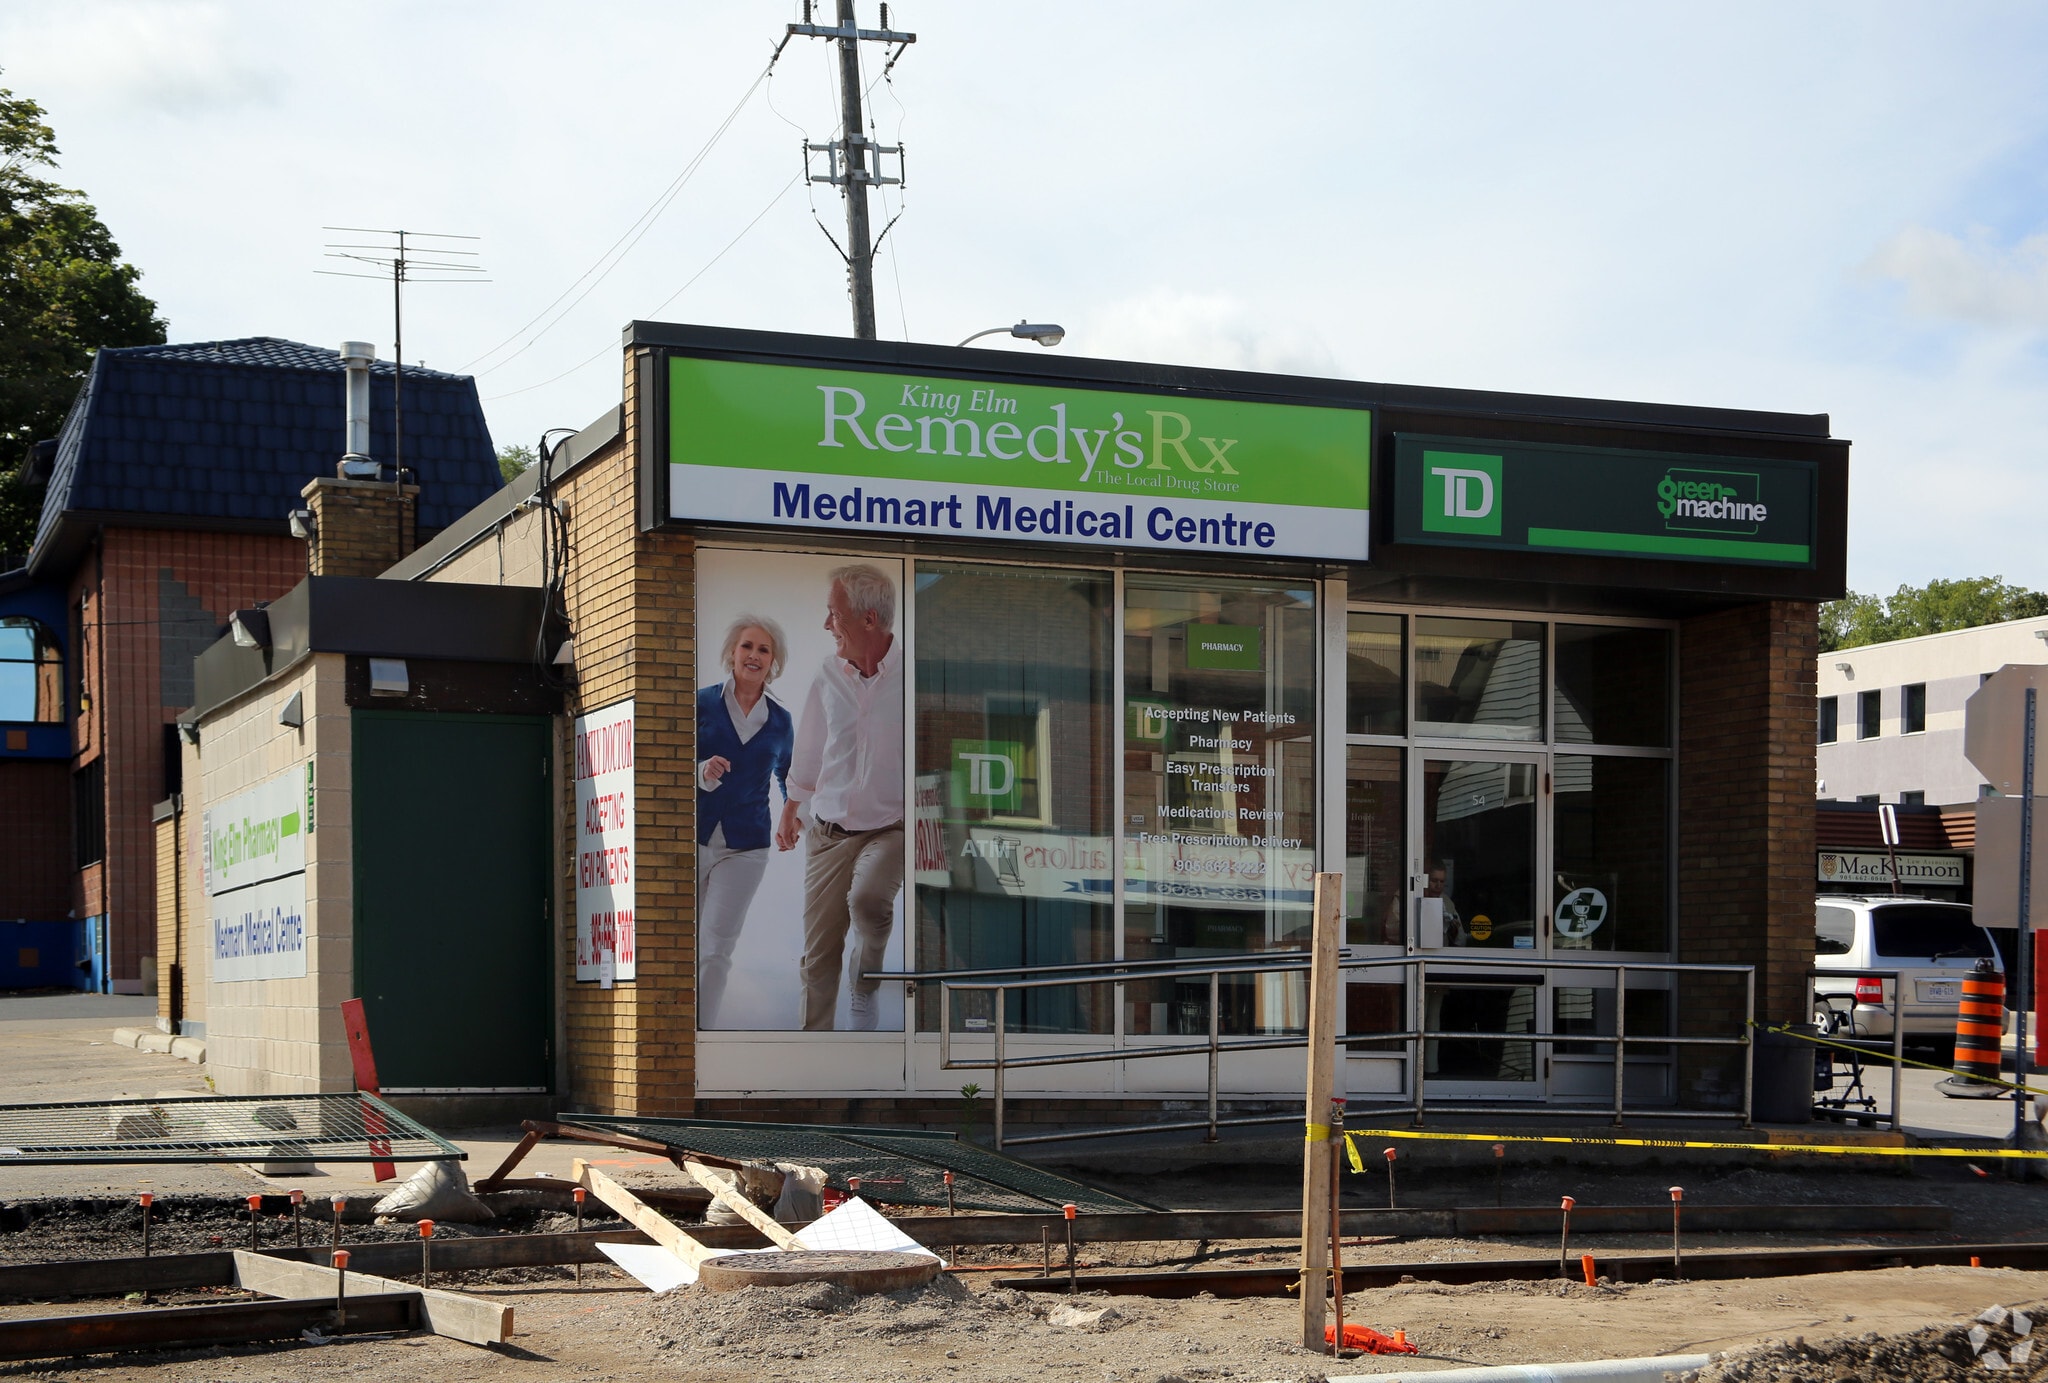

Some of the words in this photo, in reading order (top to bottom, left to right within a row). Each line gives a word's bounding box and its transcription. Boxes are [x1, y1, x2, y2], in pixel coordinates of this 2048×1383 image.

[900, 384, 960, 417] King
[968, 388, 1018, 415] Elm
[1095, 470, 1122, 485] The
[1126, 473, 1162, 487] Local
[1166, 475, 1201, 494] Drug
[1204, 478, 1240, 493] Store
[1431, 467, 1494, 518] TD
[1657, 475, 1723, 519] green
[1677, 496, 1767, 521] machine
[773, 482, 962, 529] Medmart
[976, 494, 1134, 539] Medical
[1146, 505, 1276, 548] Centre
[1201, 642, 1244, 653] PHARMACY
[1144, 706, 1210, 723] Accepting
[1213, 709, 1240, 722] New
[1243, 710, 1296, 724] Patients
[577, 729, 602, 780] FAMILY
[603, 719, 633, 774] DOCTOR
[1189, 735, 1252, 751] Pharmacy
[959, 753, 1015, 796] TD
[1166, 761, 1196, 777] Easy
[1199, 762, 1276, 779] Prescription
[1191, 779, 1251, 793] Transfers
[1472, 795, 1486, 806] 54
[585, 791, 625, 836] ACCEPTING
[1157, 805, 1235, 819] Medications
[1239, 808, 1284, 821] Review
[229, 822, 242, 866] Elm
[243, 816, 280, 864] Pharmacy
[960, 839, 1011, 858] ATM
[1139, 831, 1168, 844] Free
[1172, 832, 1248, 848] Prescription
[1252, 834, 1302, 850] Delivery
[580, 851, 595, 888] NEW
[596, 845, 629, 887] PATIENTS
[1839, 855, 1961, 878] MacKinnon
[214, 915, 244, 960] Medmart
[245, 908, 274, 956] Medical
[276, 905, 302, 953] Centre
